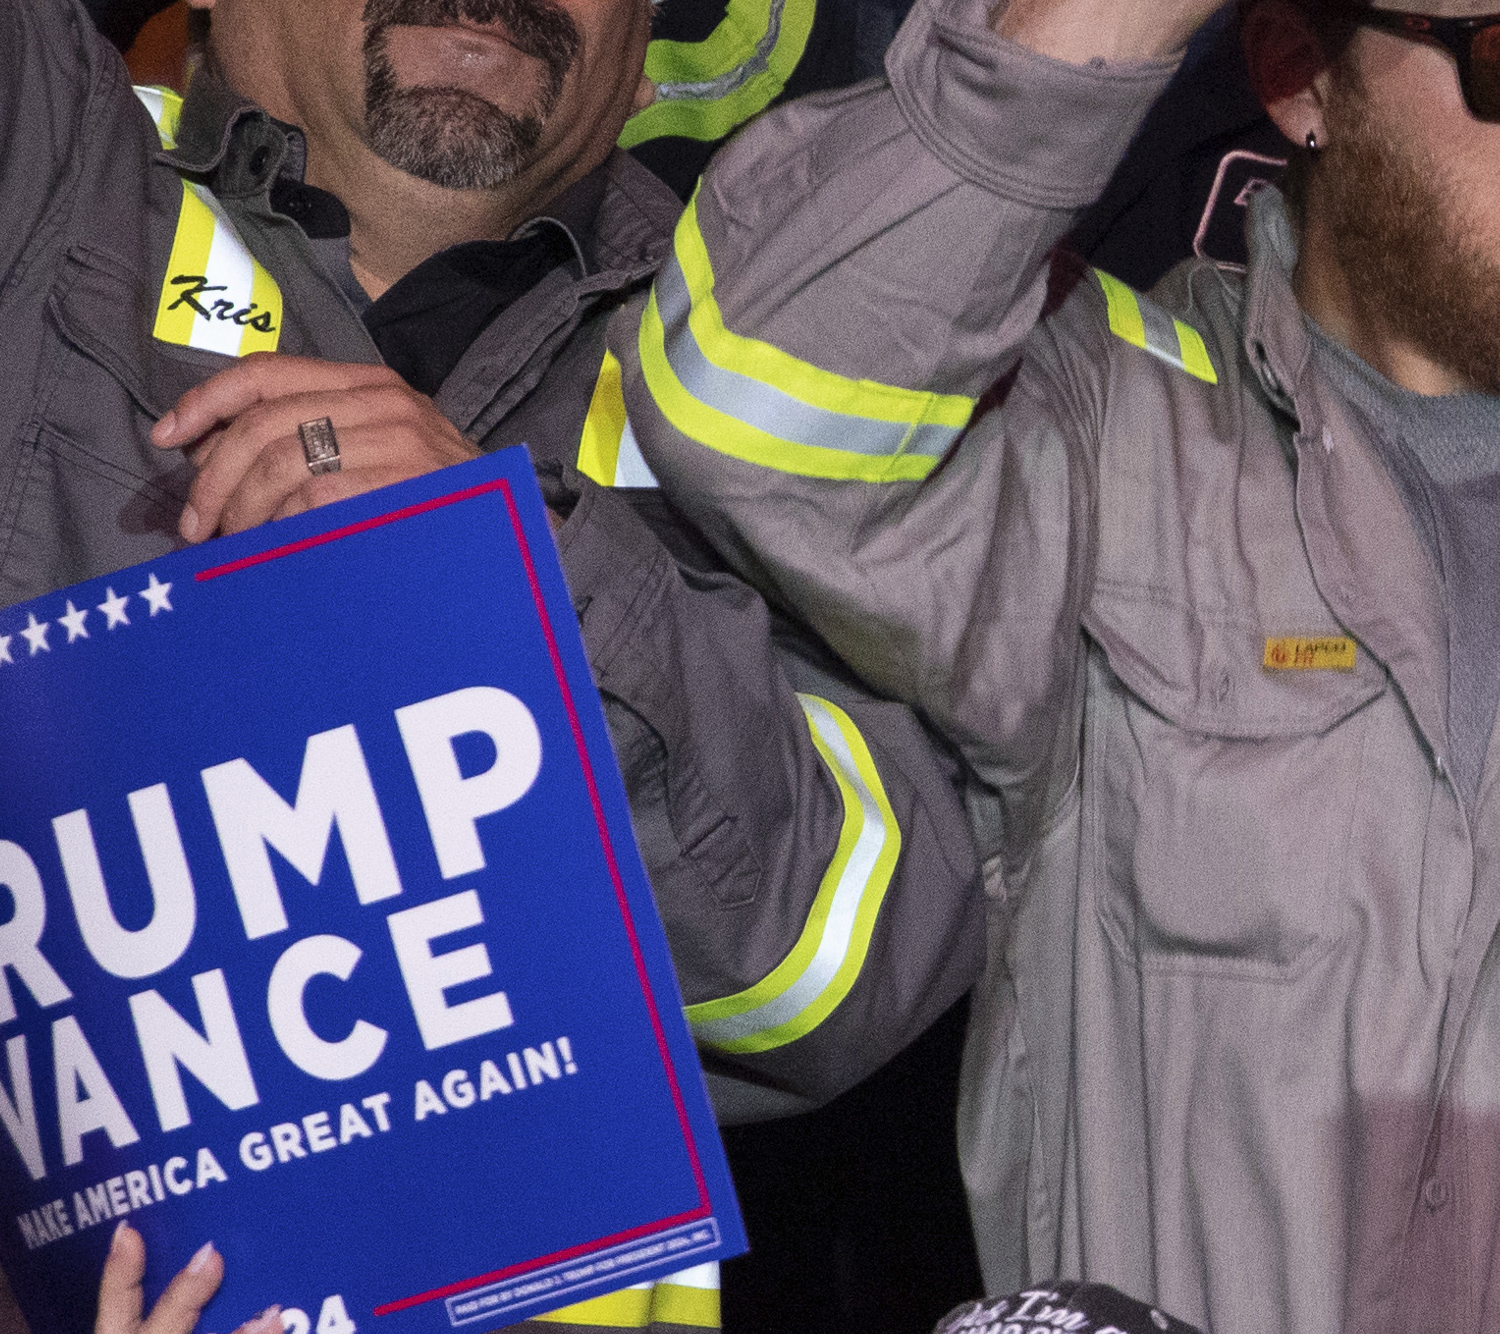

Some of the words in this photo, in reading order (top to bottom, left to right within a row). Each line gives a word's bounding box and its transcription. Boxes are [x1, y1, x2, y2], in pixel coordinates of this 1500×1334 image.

[170, 275, 277, 333] Kris
[15, 1180, 75, 1250] MAKE
[73, 1145, 227, 1237] AMERICA
[237, 1091, 392, 1175] GREAT
[412, 1034, 579, 1122] AGAIN!
[1005, 1289, 1090, 1331] I'm
